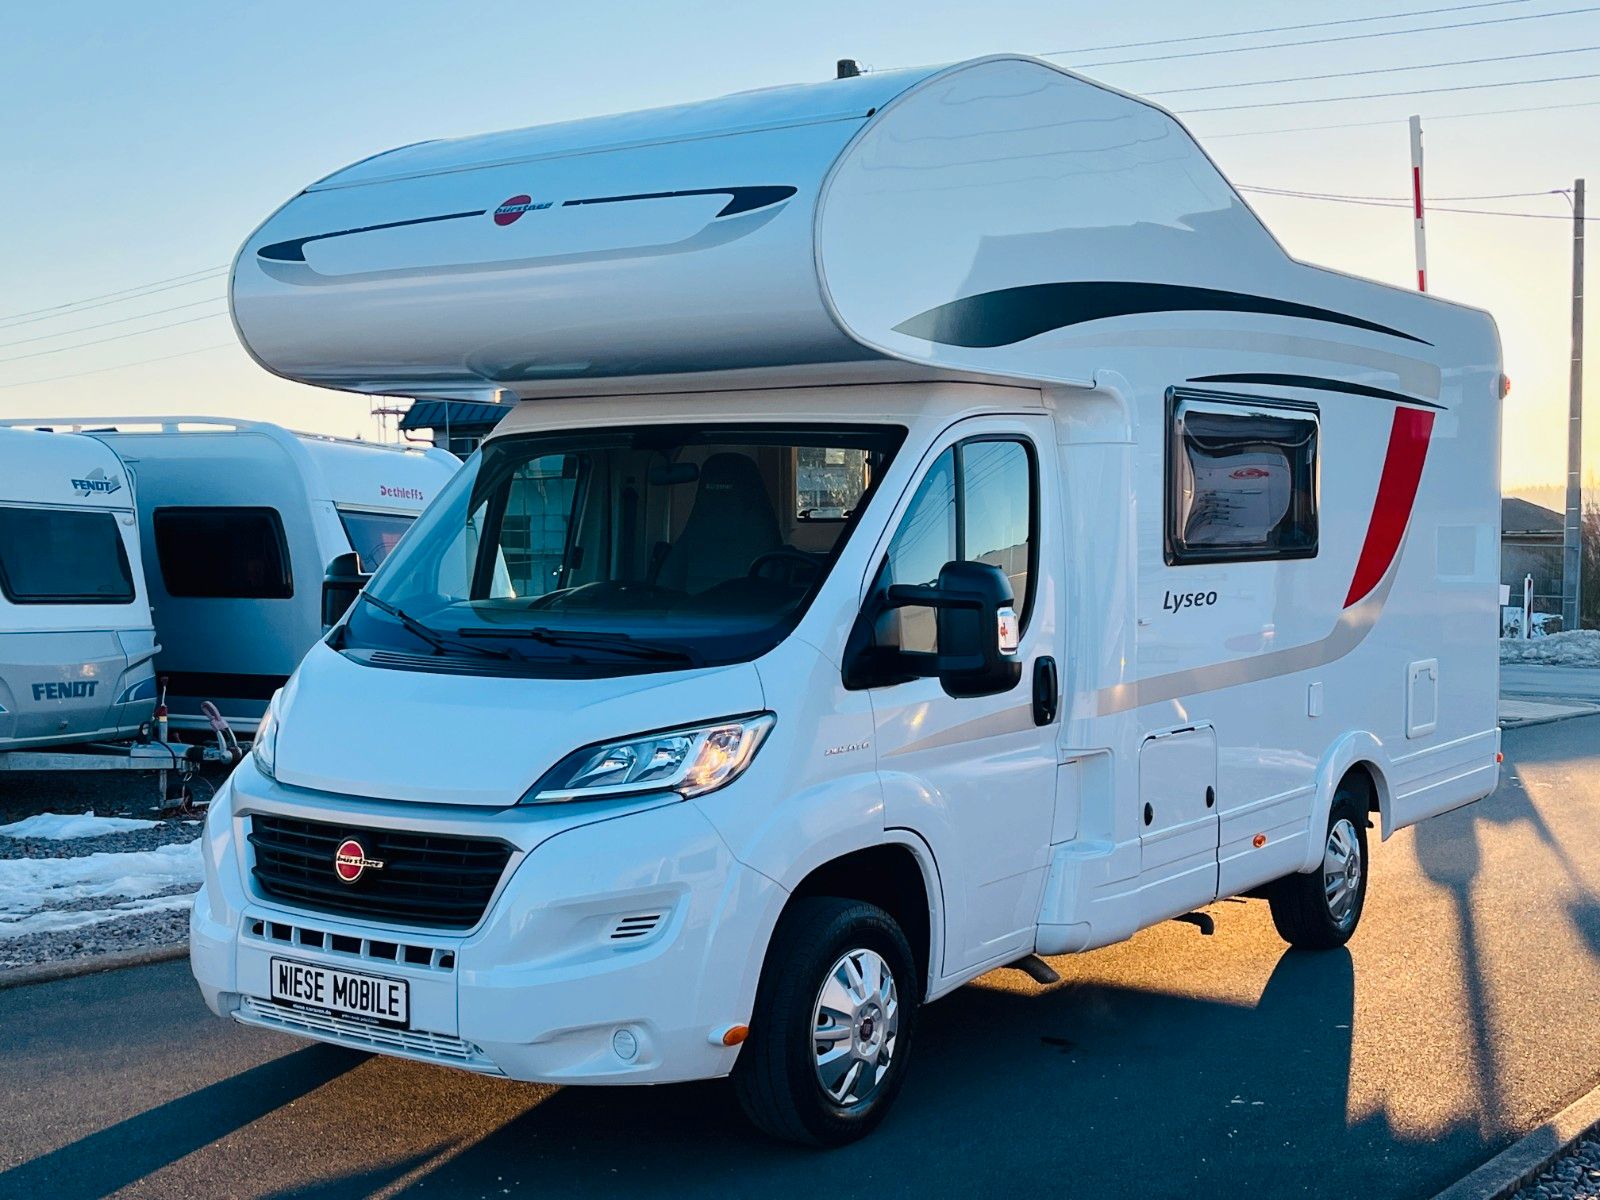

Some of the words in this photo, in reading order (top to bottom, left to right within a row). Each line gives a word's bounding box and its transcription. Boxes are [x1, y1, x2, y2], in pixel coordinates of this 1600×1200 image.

[71, 479, 111, 491] FENDT
[380, 485, 424, 500] Dethleffs
[1163, 590, 1218, 614] Lyseo
[31, 680, 99, 701] FENDT
[279, 964, 325, 1003] NIESE
[333, 974, 400, 1017] MOBILE
